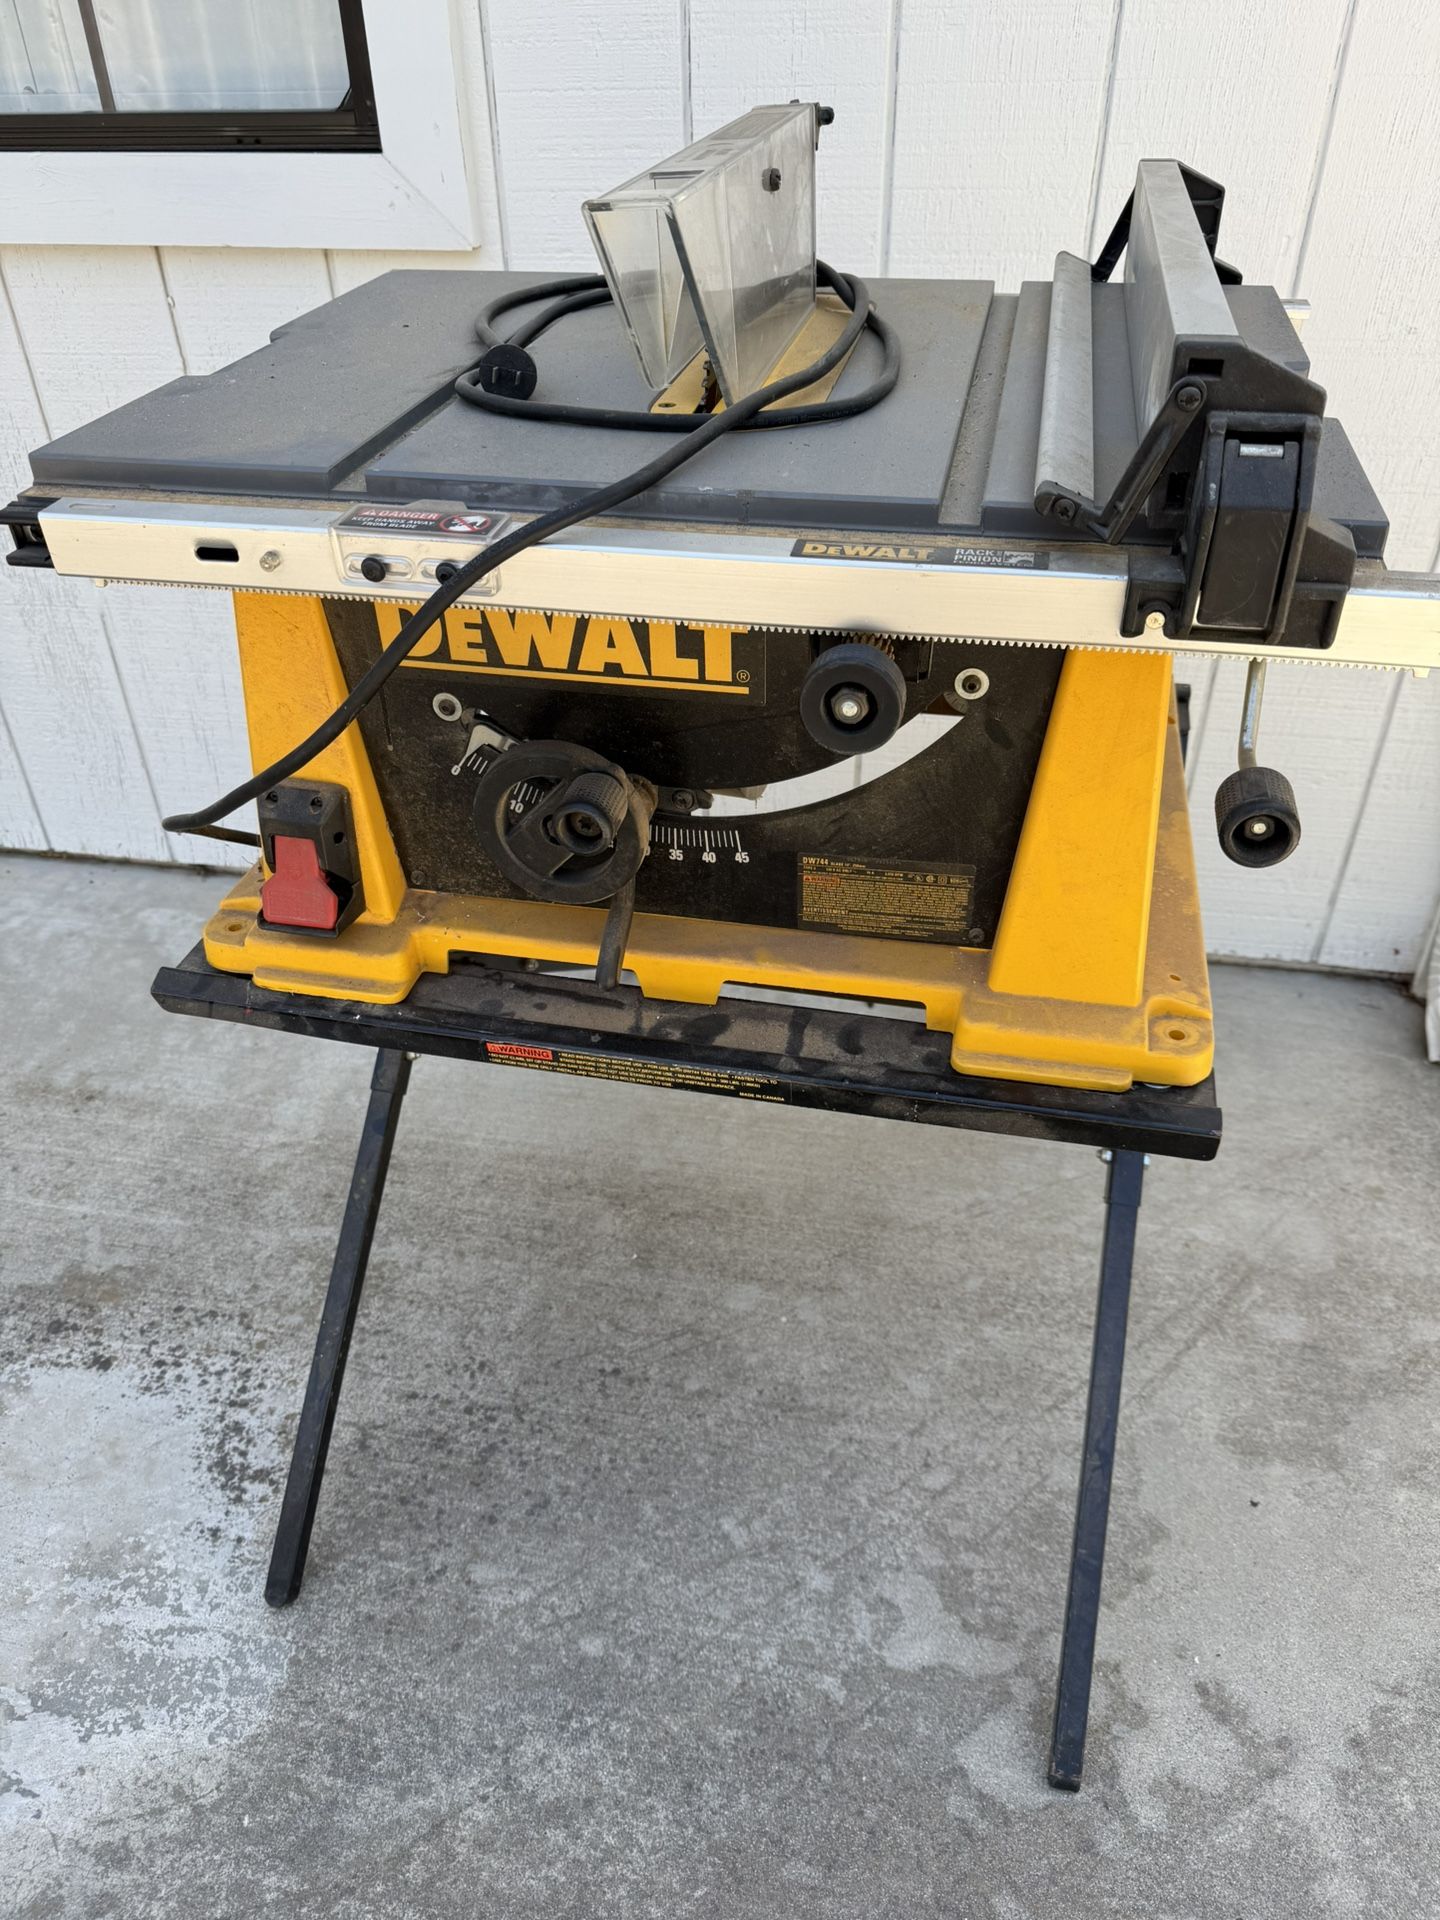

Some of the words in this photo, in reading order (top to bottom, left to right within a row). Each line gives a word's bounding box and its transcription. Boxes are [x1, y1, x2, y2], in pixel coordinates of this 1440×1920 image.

[379, 509, 438, 519] DANGER
[375, 517, 405, 525] HANDS
[955, 548, 994, 556] RACK
[953, 554, 1002, 564] PINION
[450, 764, 461, 776] 0
[509, 800, 524, 813] 10
[668, 849, 684, 861] 35
[702, 851, 717, 864] 40
[734, 851, 750, 864] 45
[802, 856, 828, 866] DW744
[498, 1045, 549, 1058] WARNING
